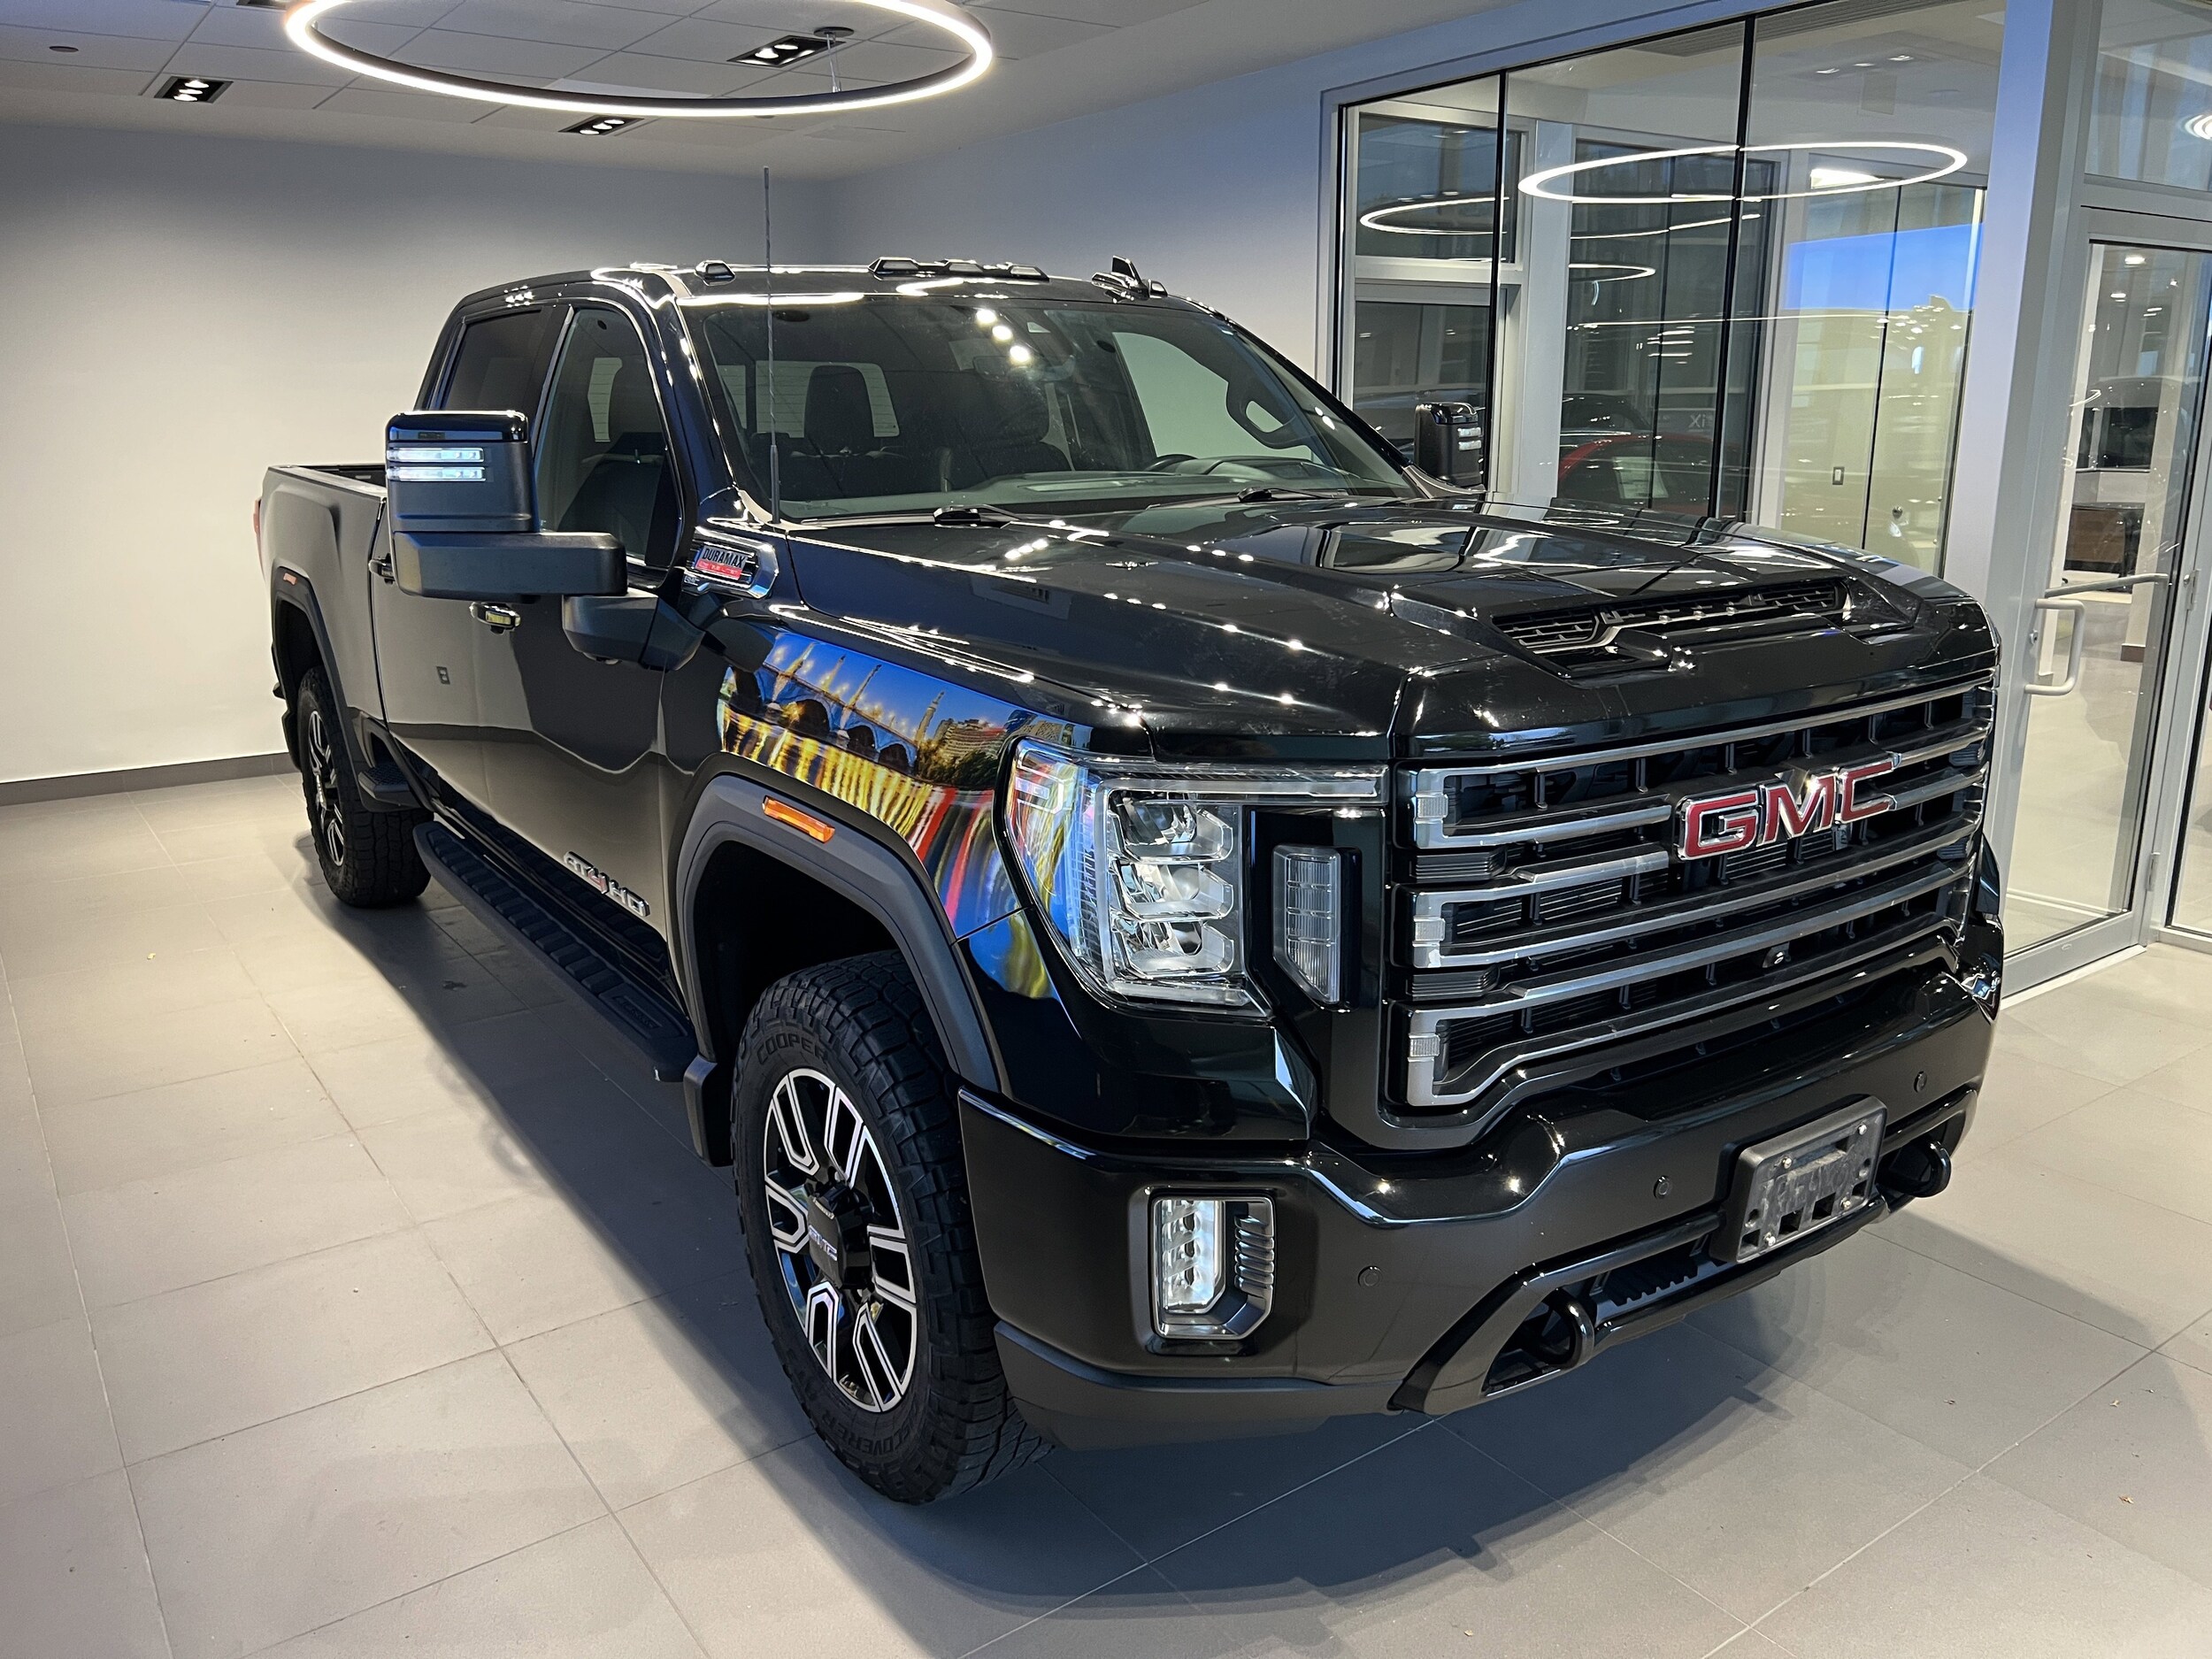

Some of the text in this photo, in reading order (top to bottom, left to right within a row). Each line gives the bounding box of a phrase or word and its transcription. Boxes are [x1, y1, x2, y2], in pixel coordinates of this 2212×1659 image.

[702, 548, 746, 569] DURAMAX
[1677, 751, 1901, 861] GMC
[757, 1032, 829, 1065] COOPER
